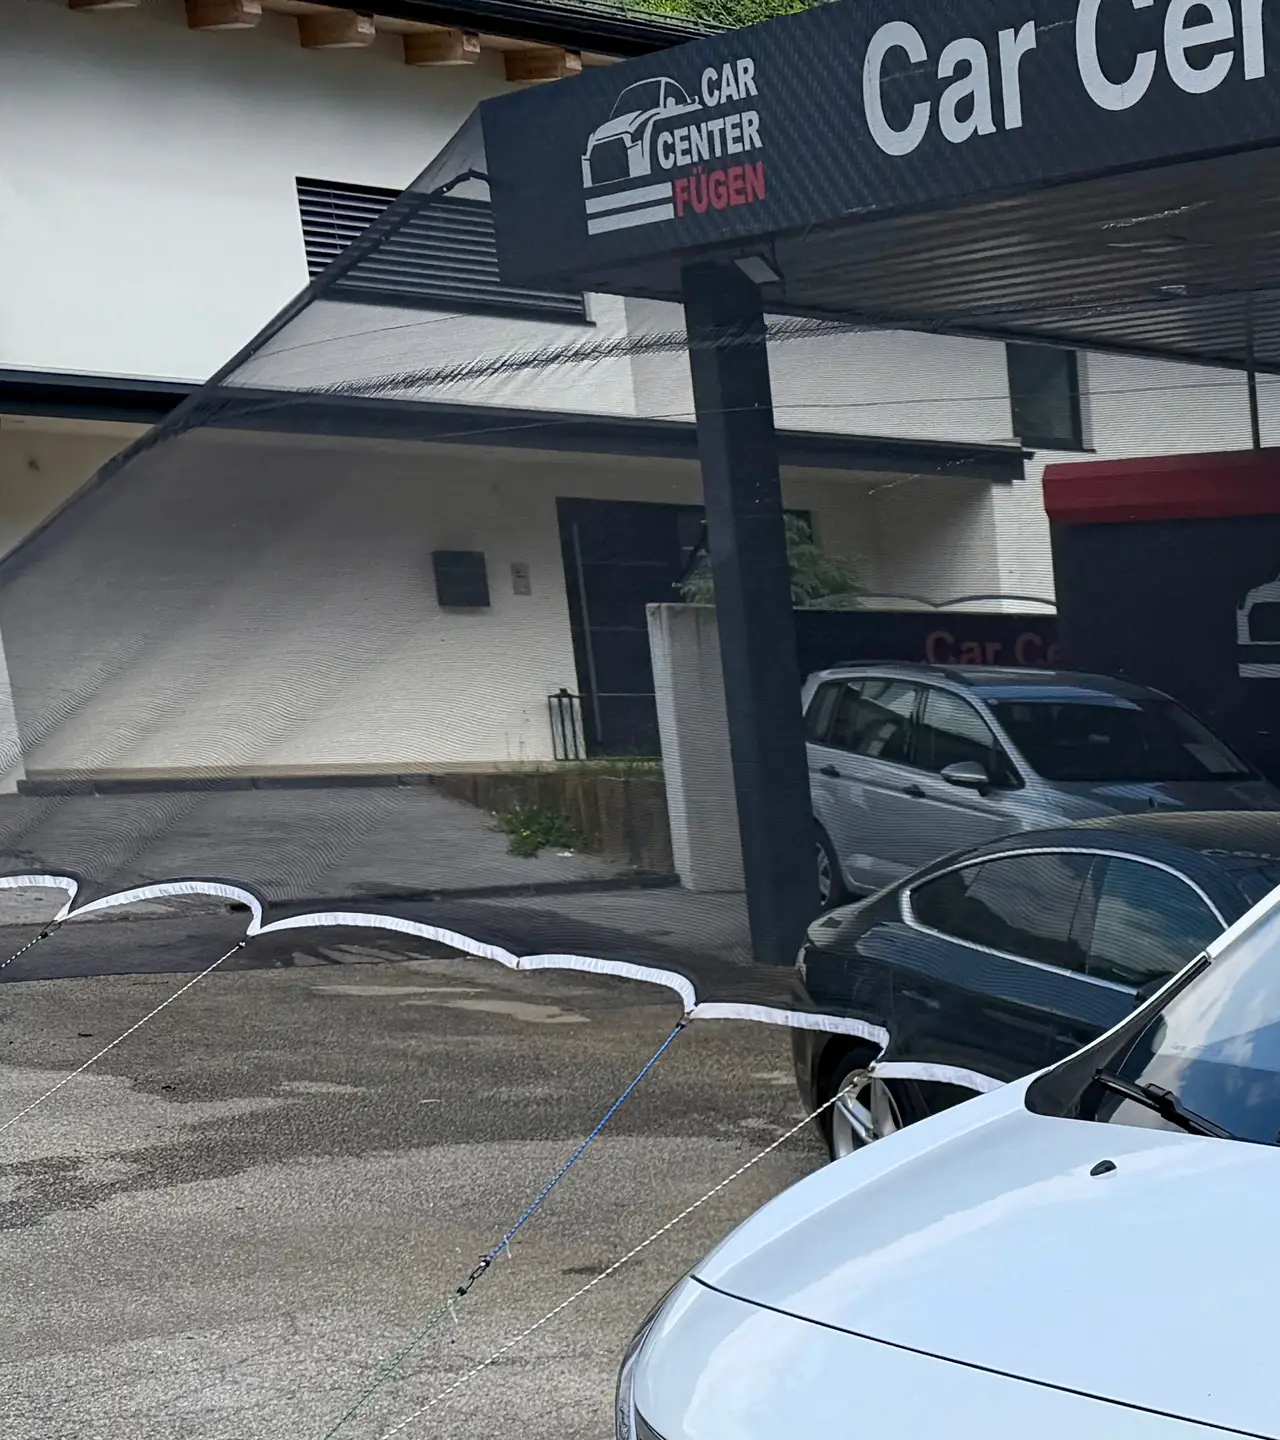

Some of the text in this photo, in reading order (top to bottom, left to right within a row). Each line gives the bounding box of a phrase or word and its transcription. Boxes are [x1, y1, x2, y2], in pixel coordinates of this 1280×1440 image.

[701, 57, 759, 107] CAR
[863, 20, 1037, 156] Car
[657, 110, 763, 170] CENTER
[674, 161, 766, 218] FÜGEN
[925, 630, 1002, 665] Car
